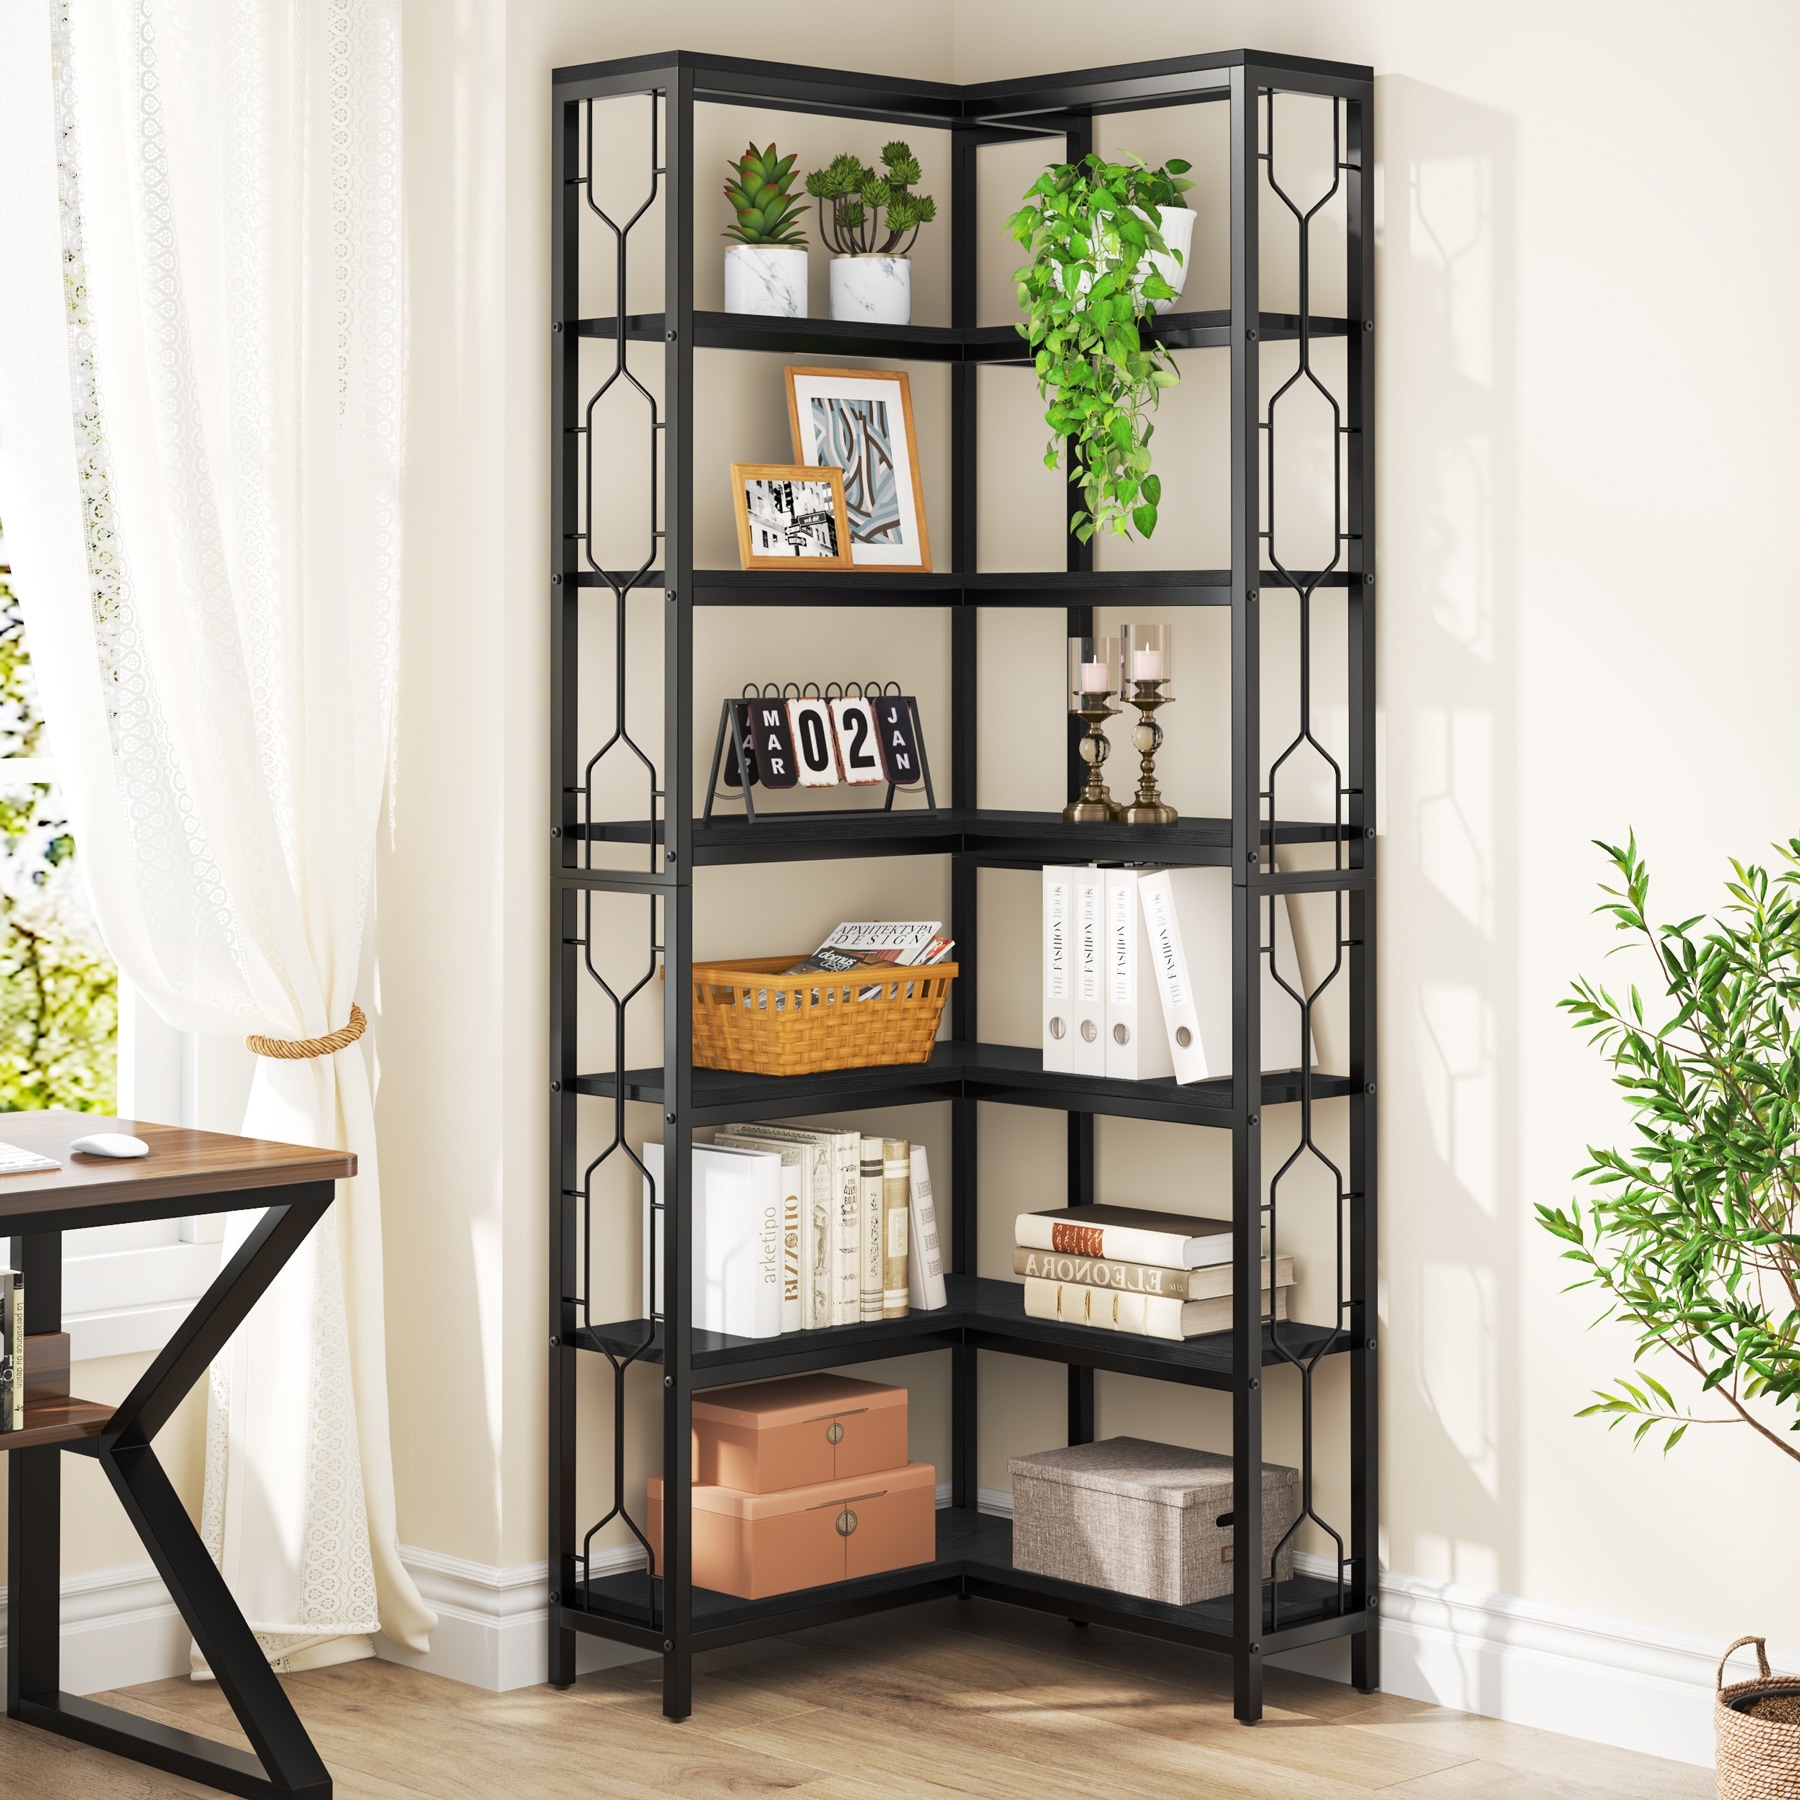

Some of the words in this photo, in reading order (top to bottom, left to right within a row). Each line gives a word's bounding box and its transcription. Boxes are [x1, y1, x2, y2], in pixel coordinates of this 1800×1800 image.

[762, 709, 786, 775] MAR
[887, 707, 911, 770] JAN
[1053, 886, 1063, 918] BOOK
[1084, 887, 1093, 920] BOOK
[1117, 890, 1126, 923] BOOK
[1153, 893, 1167, 927] BOOK
[834, 934, 924, 945] DESIGN
[1053, 921, 1062, 971] FASHION
[1084, 923, 1093, 973] FASHION
[1116, 926, 1126, 976] FASHION
[1160, 928, 1177, 980] FASHION
[818, 950, 857, 966] domus
[1053, 974, 1062, 997] THE
[1084, 976, 1093, 999] THE
[759, 1206, 777, 1284] arketipo
